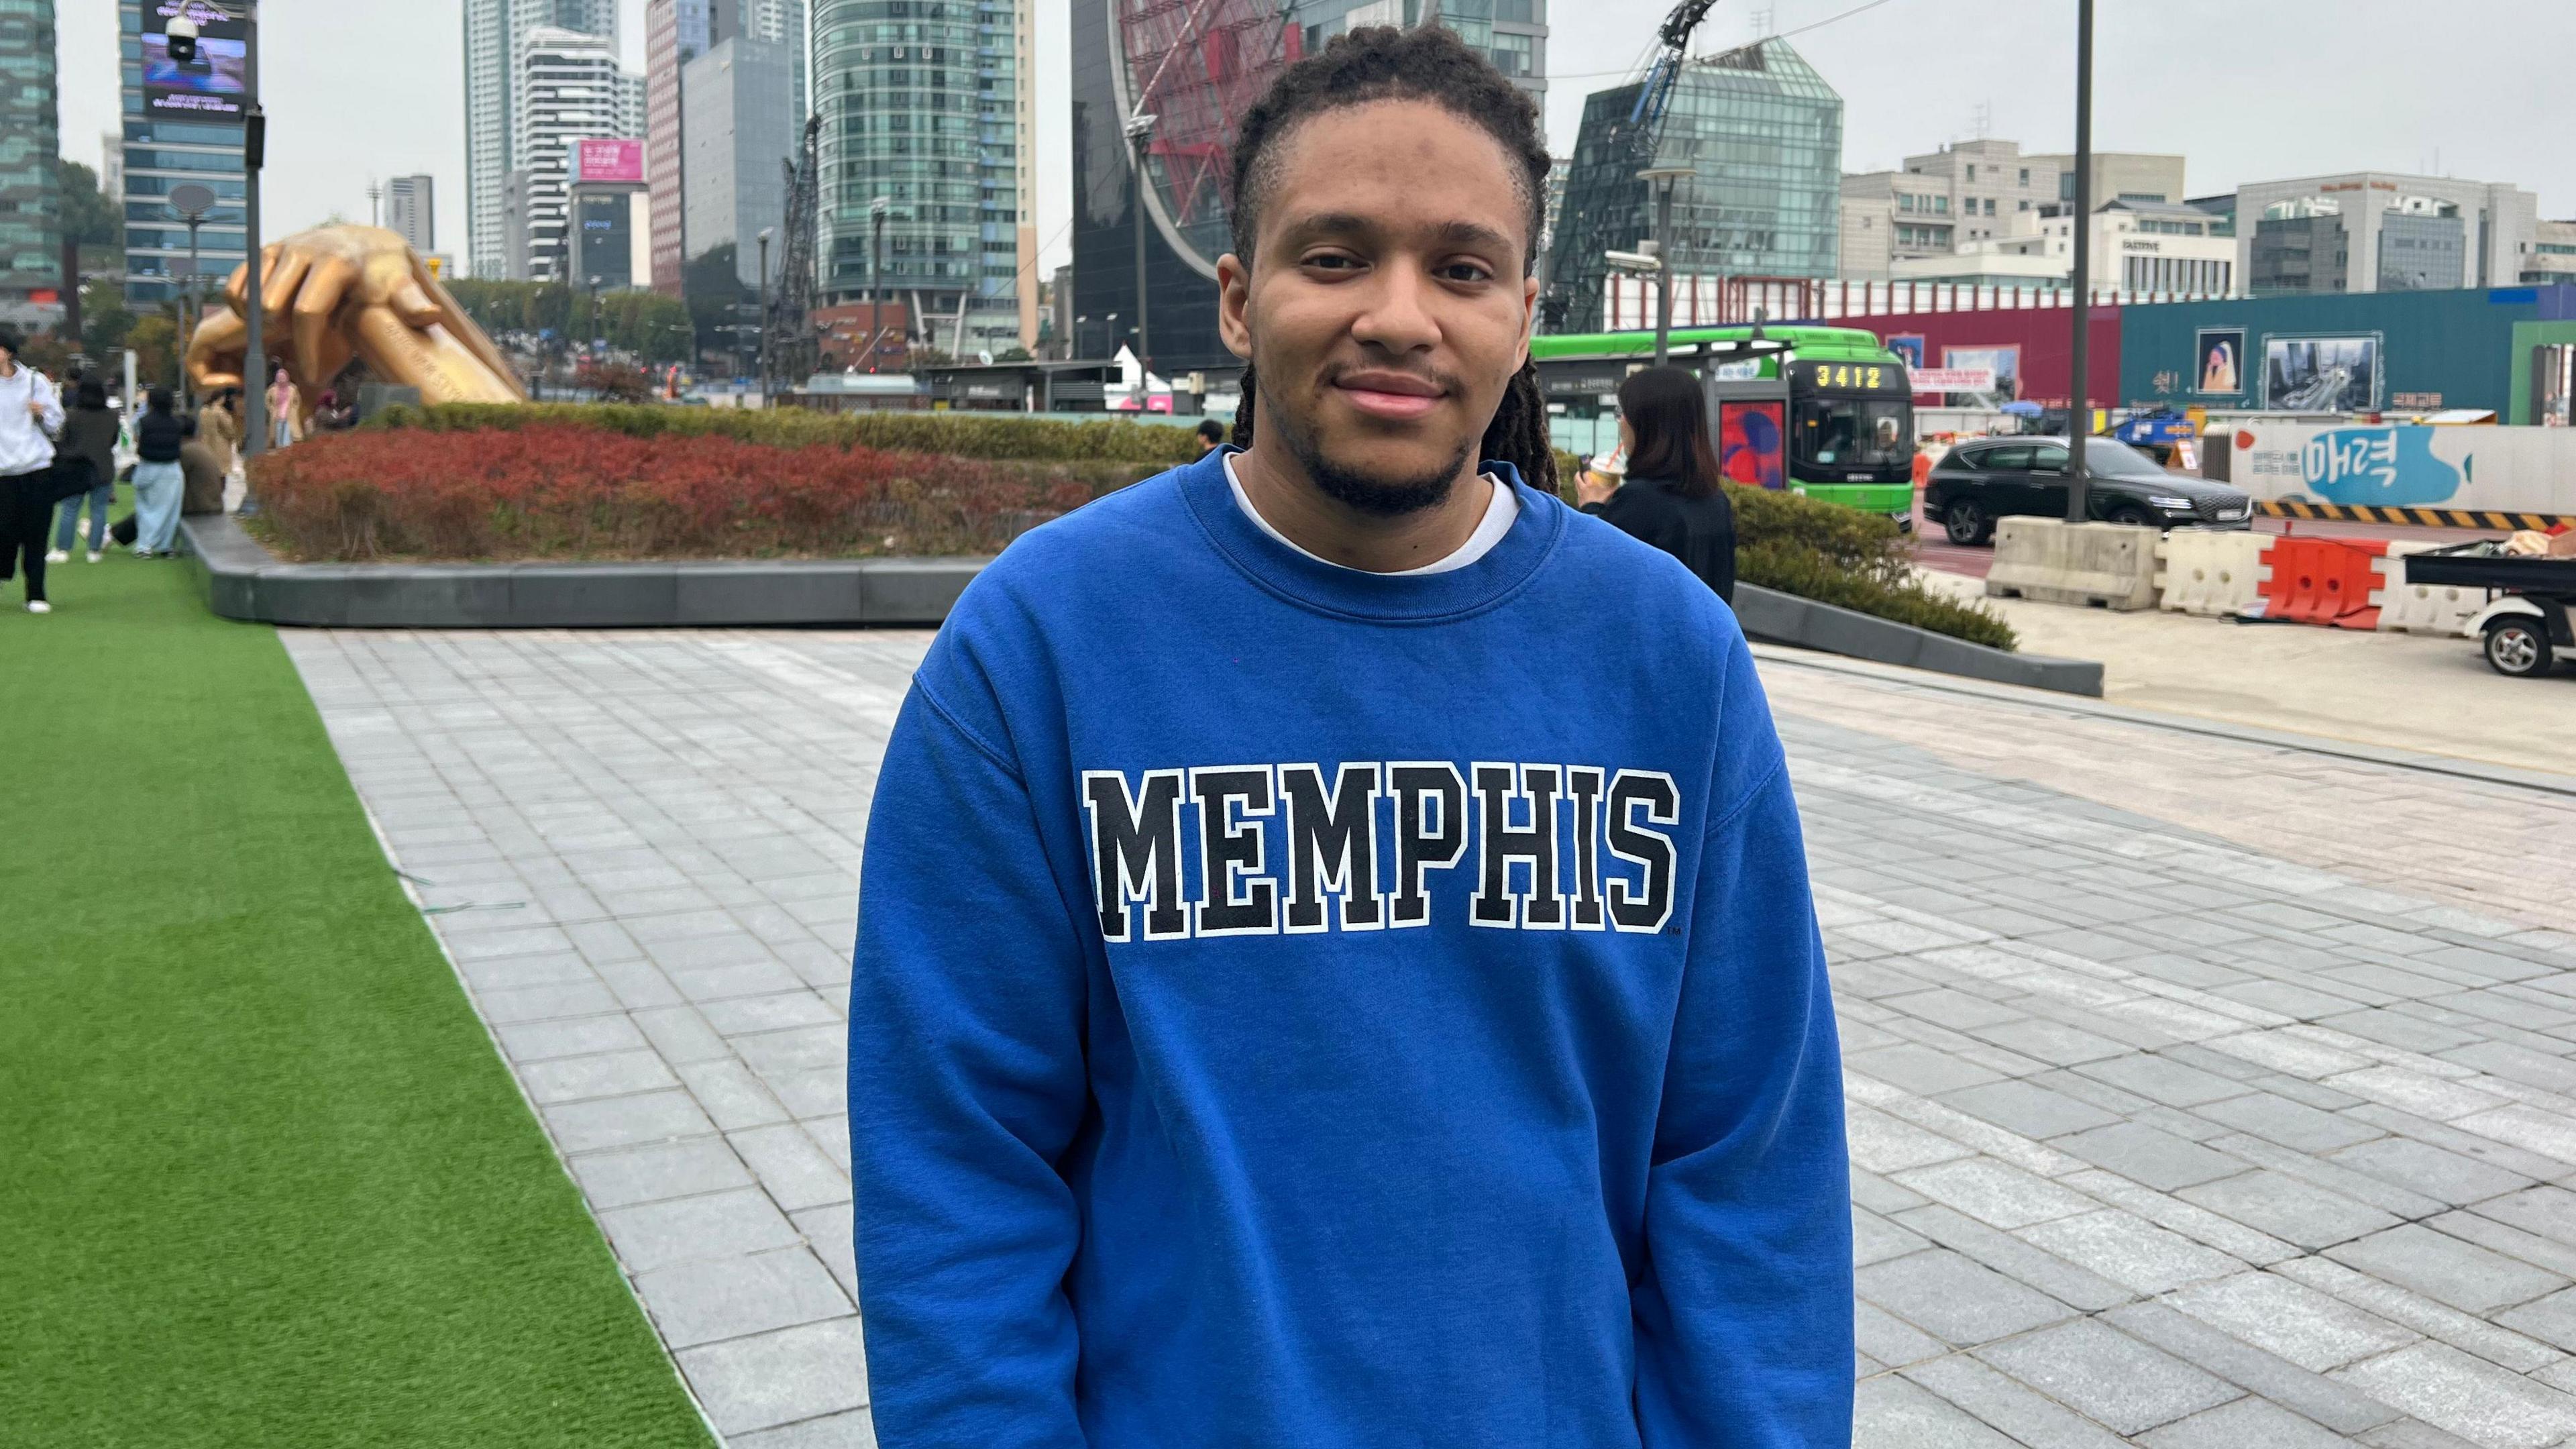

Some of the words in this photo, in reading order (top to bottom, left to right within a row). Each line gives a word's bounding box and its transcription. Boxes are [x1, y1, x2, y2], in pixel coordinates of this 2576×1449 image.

[1817, 365, 1881, 388] 3412
[2306, 429, 2397, 487] 매력
[1081, 761, 1680, 943] MEMPHIS
